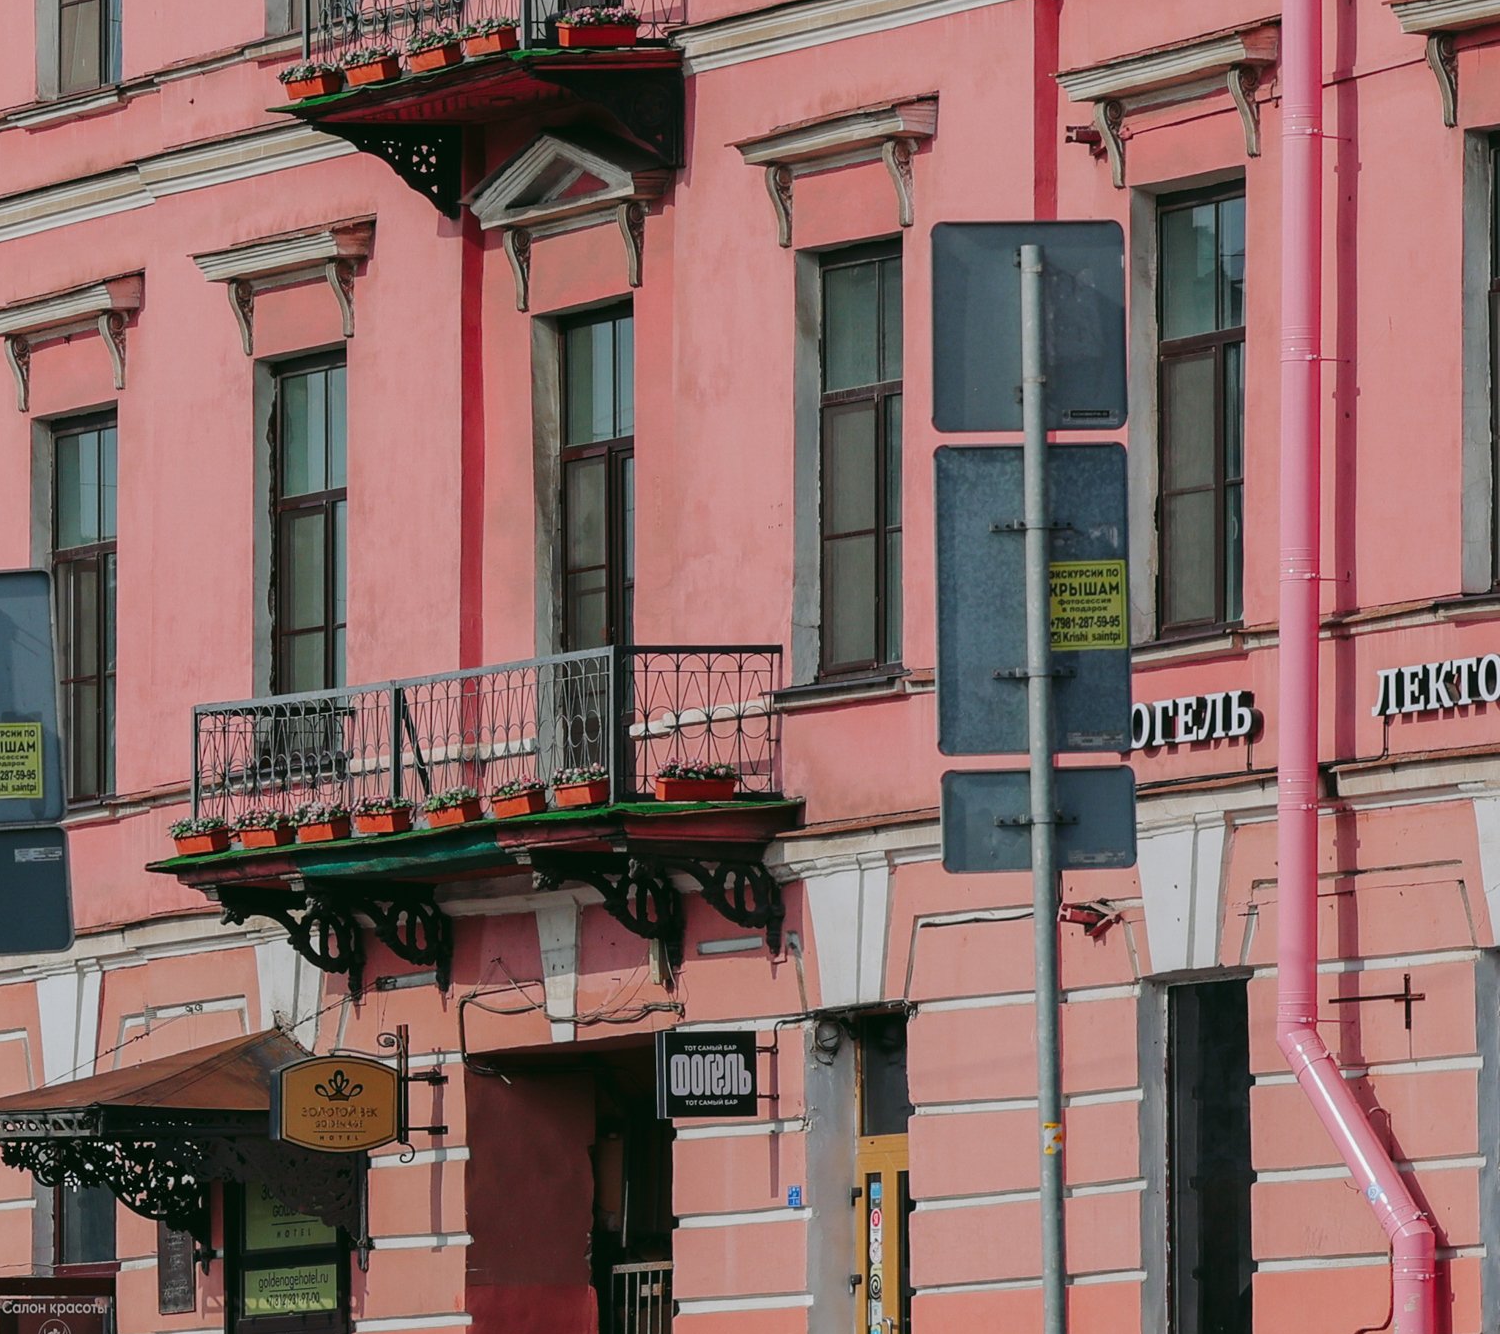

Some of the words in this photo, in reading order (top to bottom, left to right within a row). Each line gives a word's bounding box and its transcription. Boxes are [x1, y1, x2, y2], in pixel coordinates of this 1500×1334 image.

[1049, 569, 1103, 579] ЭКСКУРСИИ
[1106, 568, 1119, 577] ПО
[1050, 582, 1119, 597] КРЫШАМ
[1372, 653, 1500, 717] ЛЕКТО
[1131, 690, 1254, 749] ОГЕЛЬ
[24, 729, 35, 737] ПО
[670, 1053, 752, 1096] ФОГЕЛЬ
[301, 1106, 356, 1117] ЗОЛОТОЙ
[361, 1108, 377, 1117] ВЕК
[2, 1300, 46, 1314] Салон
[49, 1302, 108, 1316] красоты
